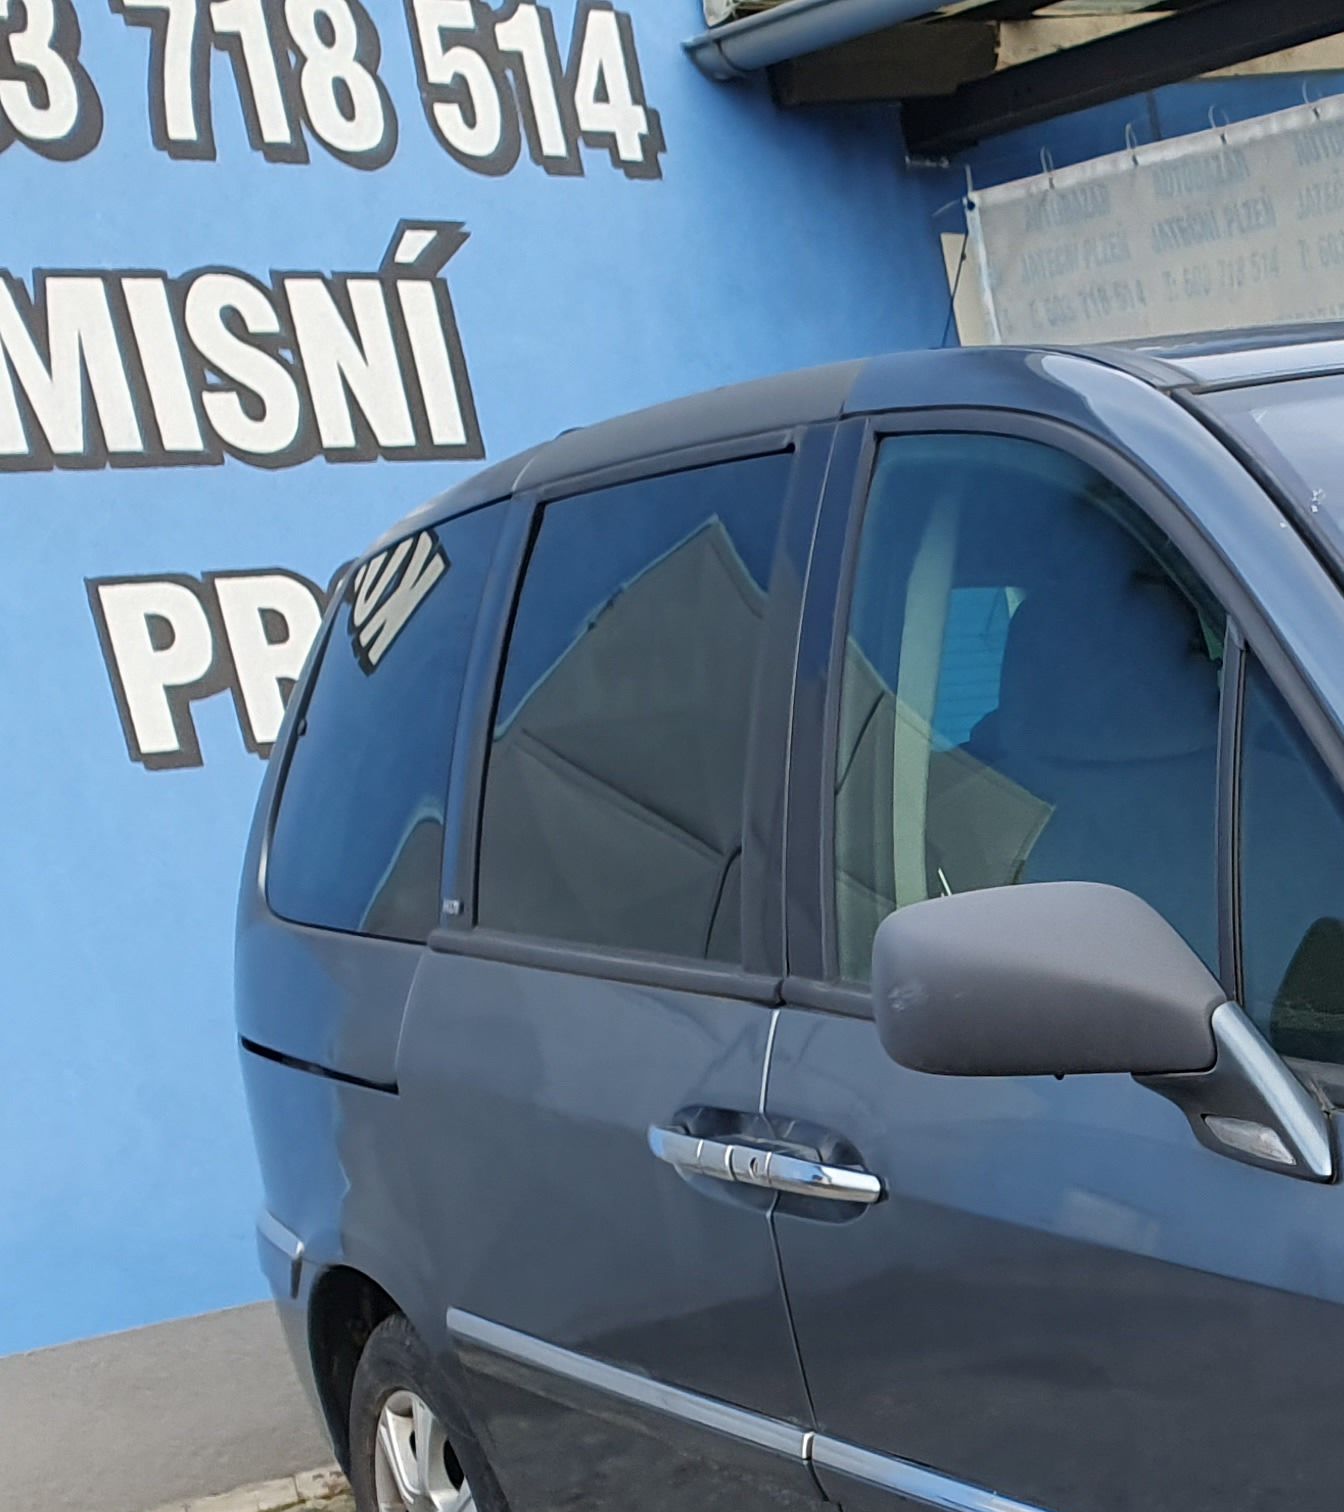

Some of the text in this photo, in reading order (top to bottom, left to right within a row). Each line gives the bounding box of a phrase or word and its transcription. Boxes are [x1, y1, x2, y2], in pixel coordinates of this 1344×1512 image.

[108, 0, 399, 170] 718
[410, 0, 666, 179] 514
[0, 220, 485, 469] MISNÍ
[84, 564, 350, 770] PR
